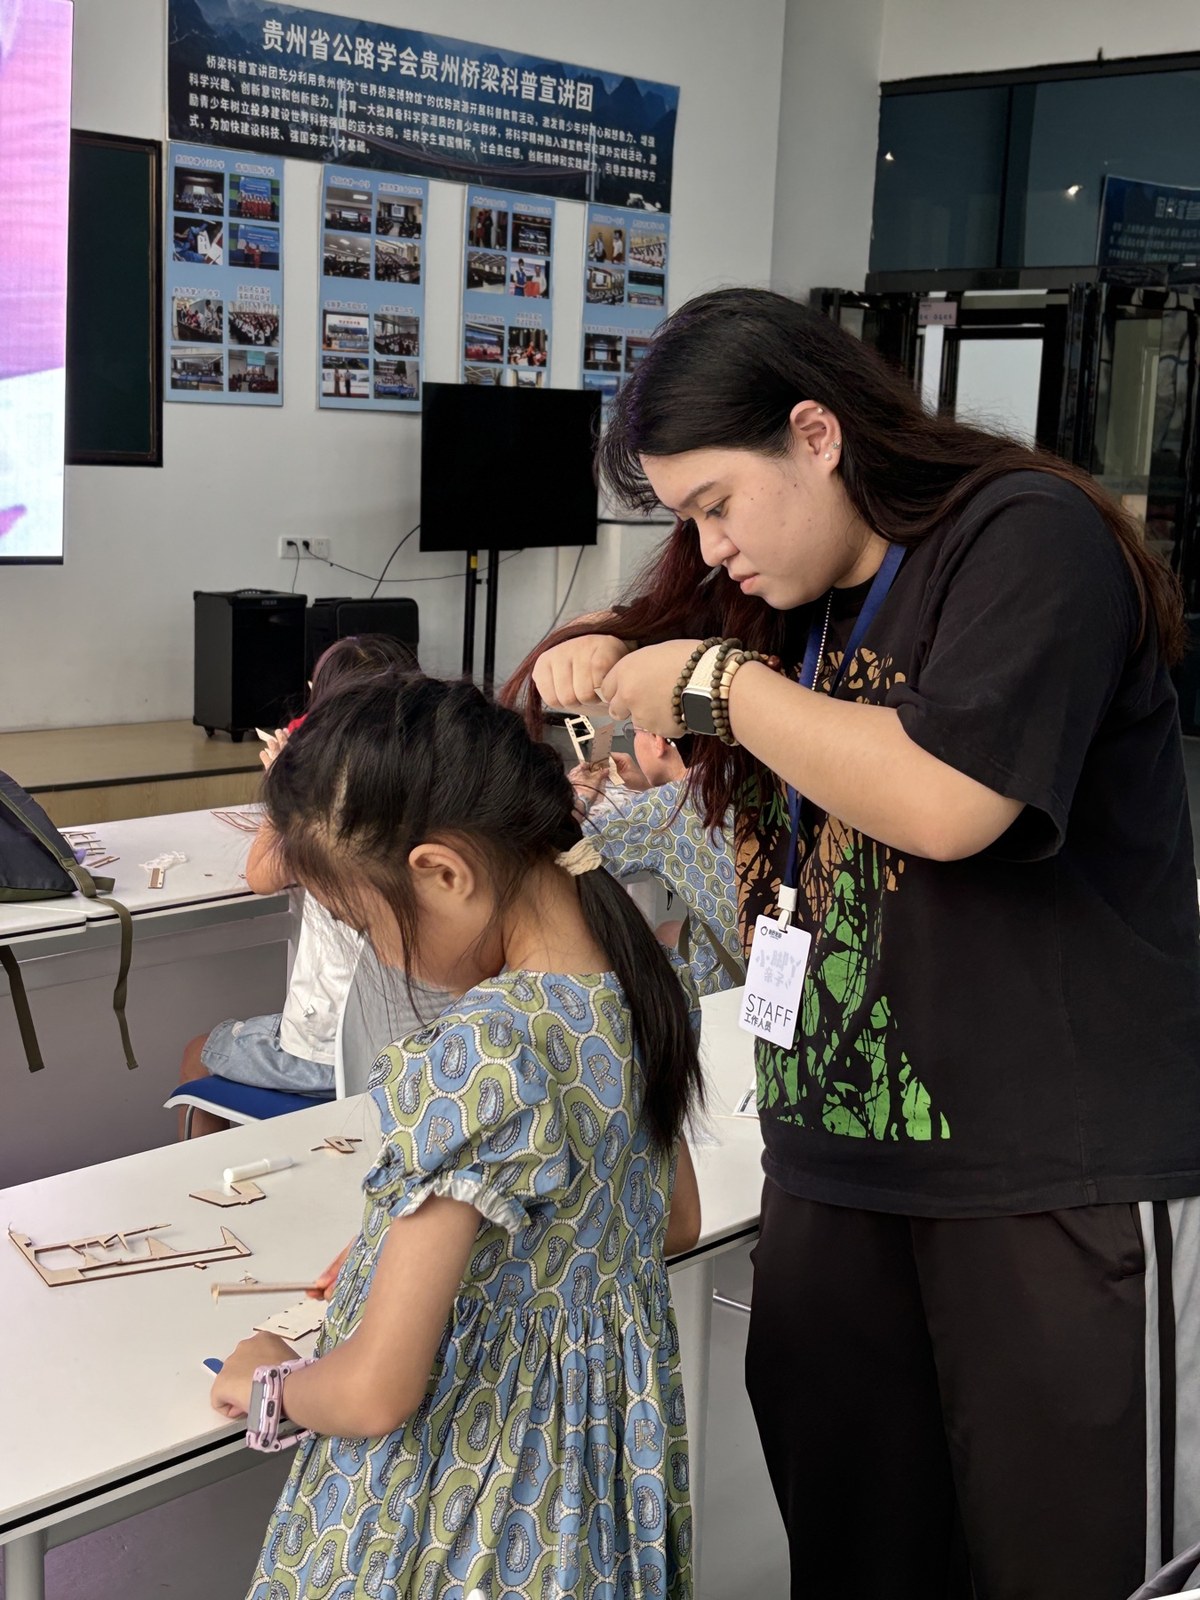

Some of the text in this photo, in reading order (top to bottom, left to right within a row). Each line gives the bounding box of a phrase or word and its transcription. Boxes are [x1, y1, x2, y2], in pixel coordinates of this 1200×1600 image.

[262, 19, 594, 112] 贵州省公路学会贵州桥梁科普宣讲团
[744, 1012, 772, 1033] 工作人员
[745, 993, 793, 1027] STAFF
